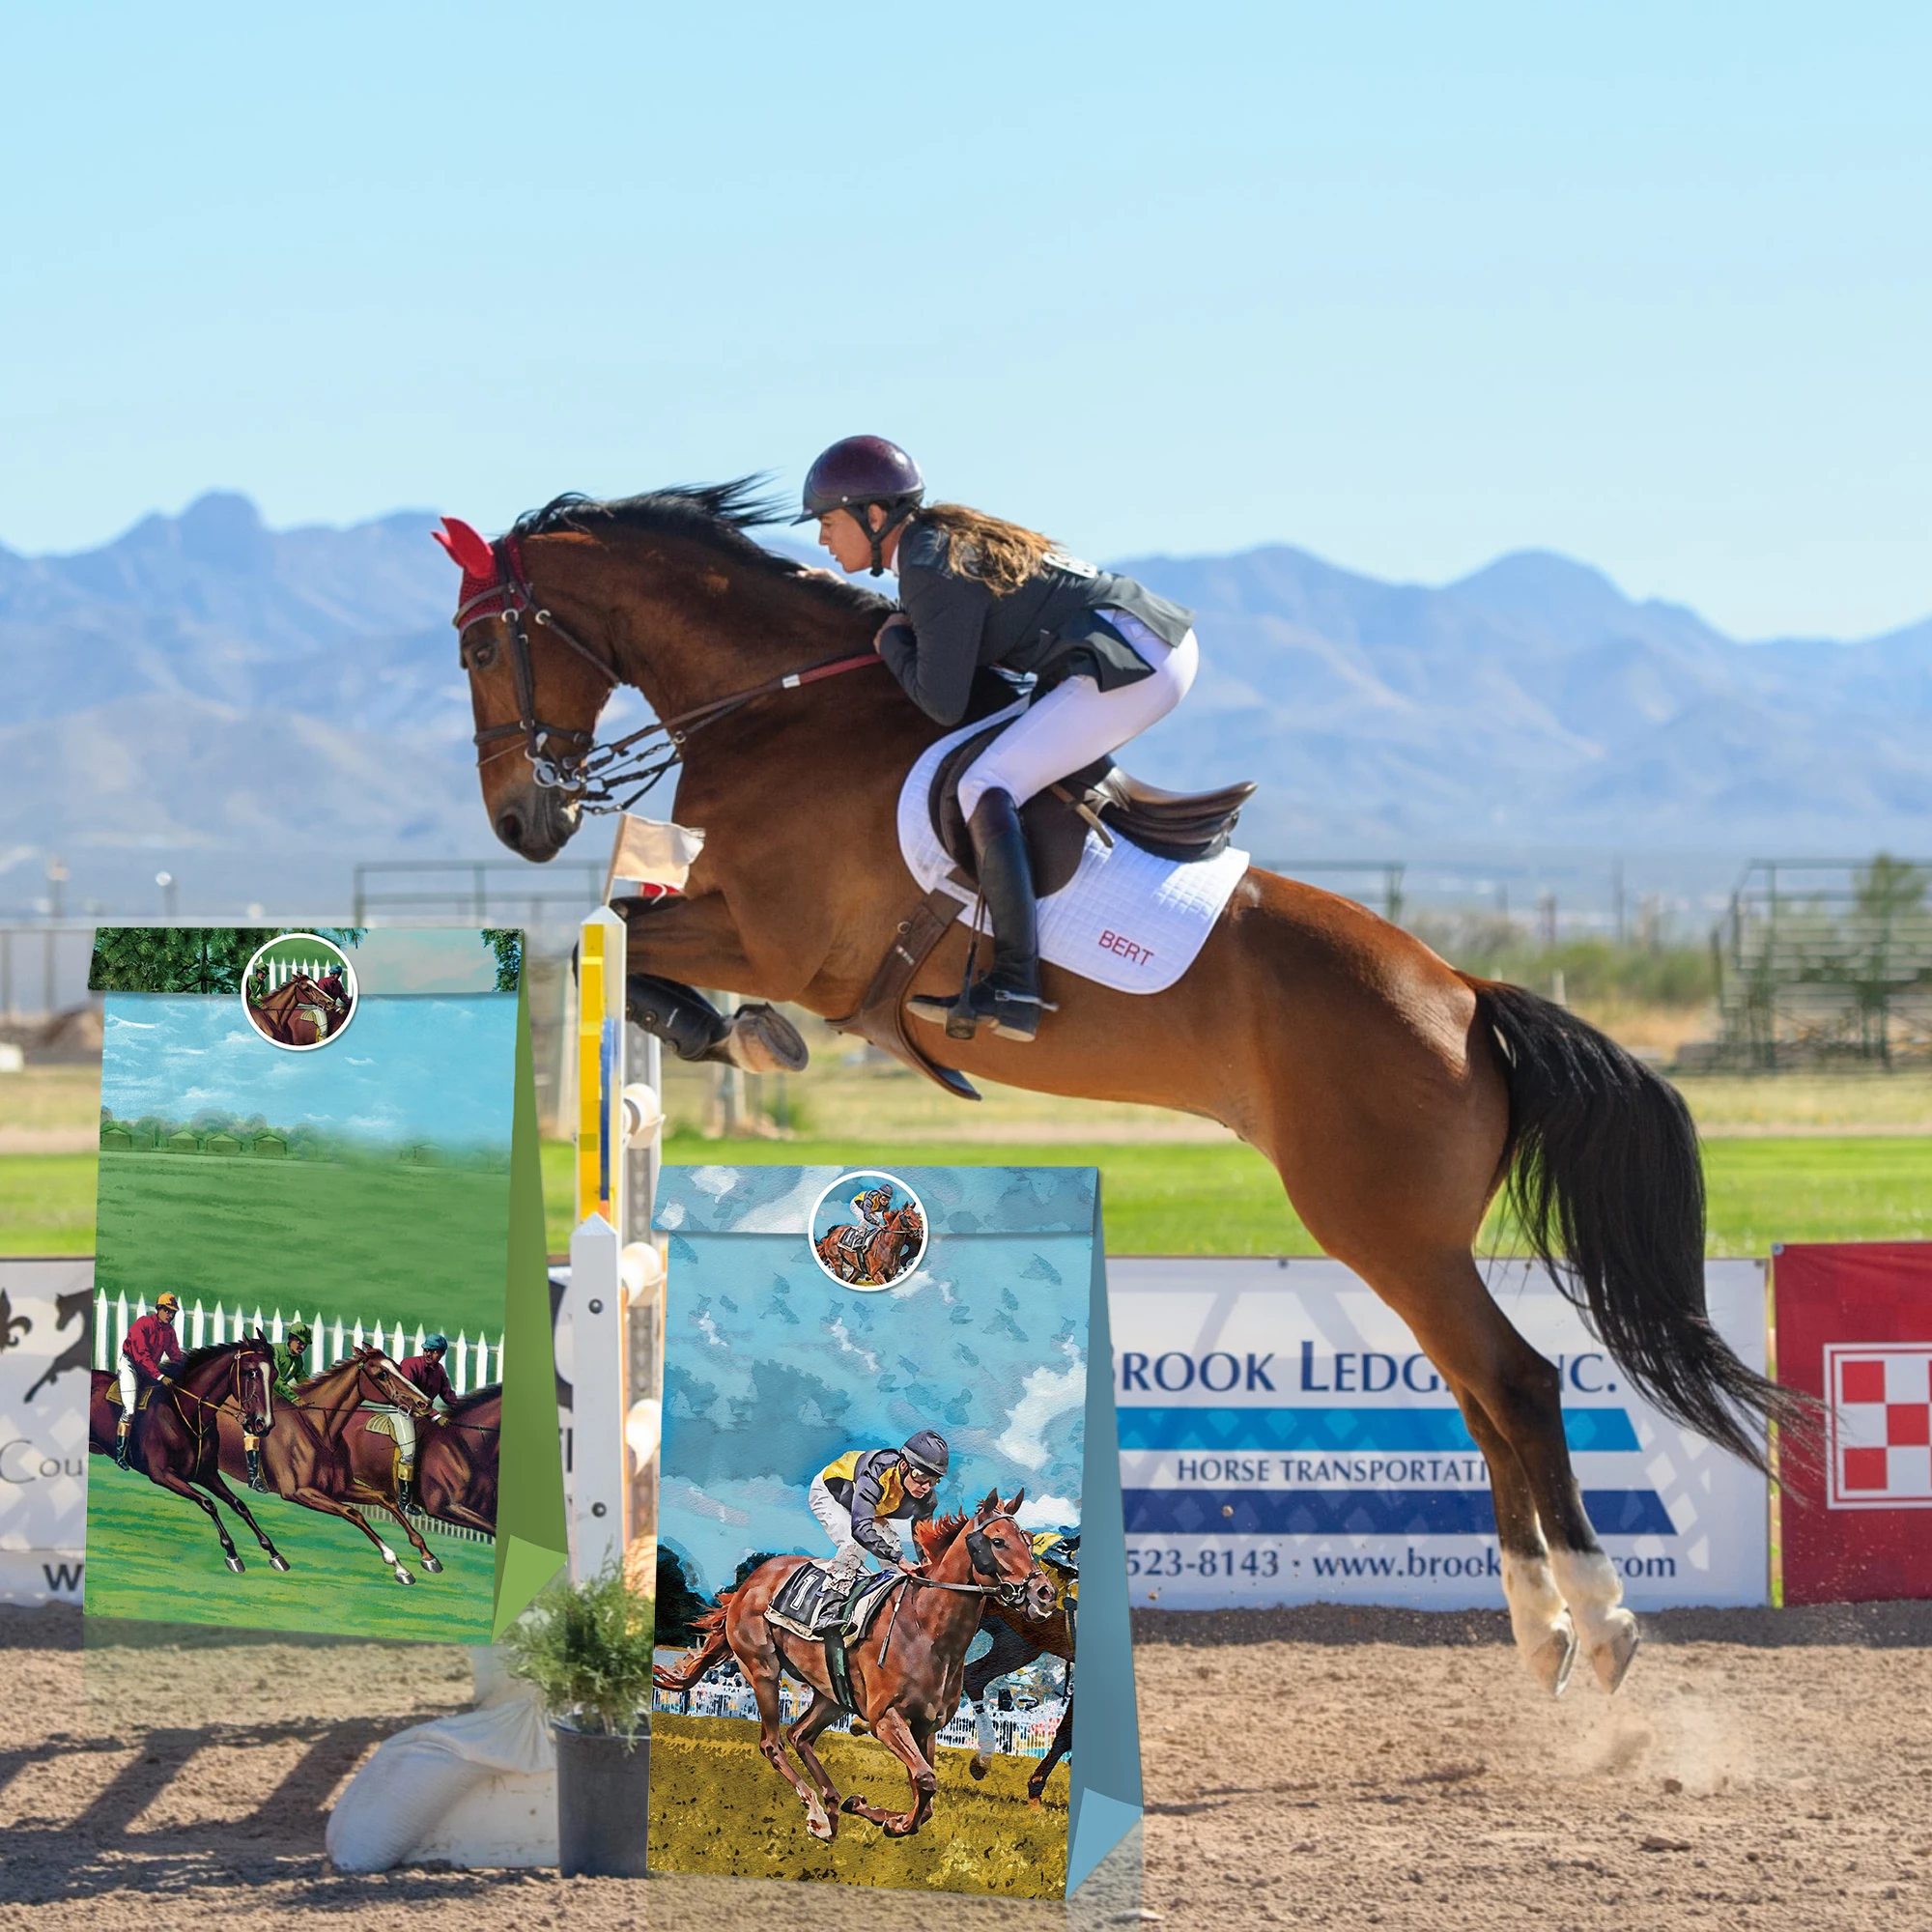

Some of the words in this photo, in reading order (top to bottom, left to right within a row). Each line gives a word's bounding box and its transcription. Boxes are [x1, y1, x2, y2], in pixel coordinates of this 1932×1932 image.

[1098, 929, 1154, 966] BERT
[1122, 1351, 1277, 1392] ROOK
[1300, 1340, 1451, 1393] LEDG
[1178, 1458, 1270, 1482] HORSE
[1280, 1458, 1487, 1482] TRANSPORTATI
[1125, 1548, 1279, 1577] 523-8143
[790, 1574, 819, 1610] 1
